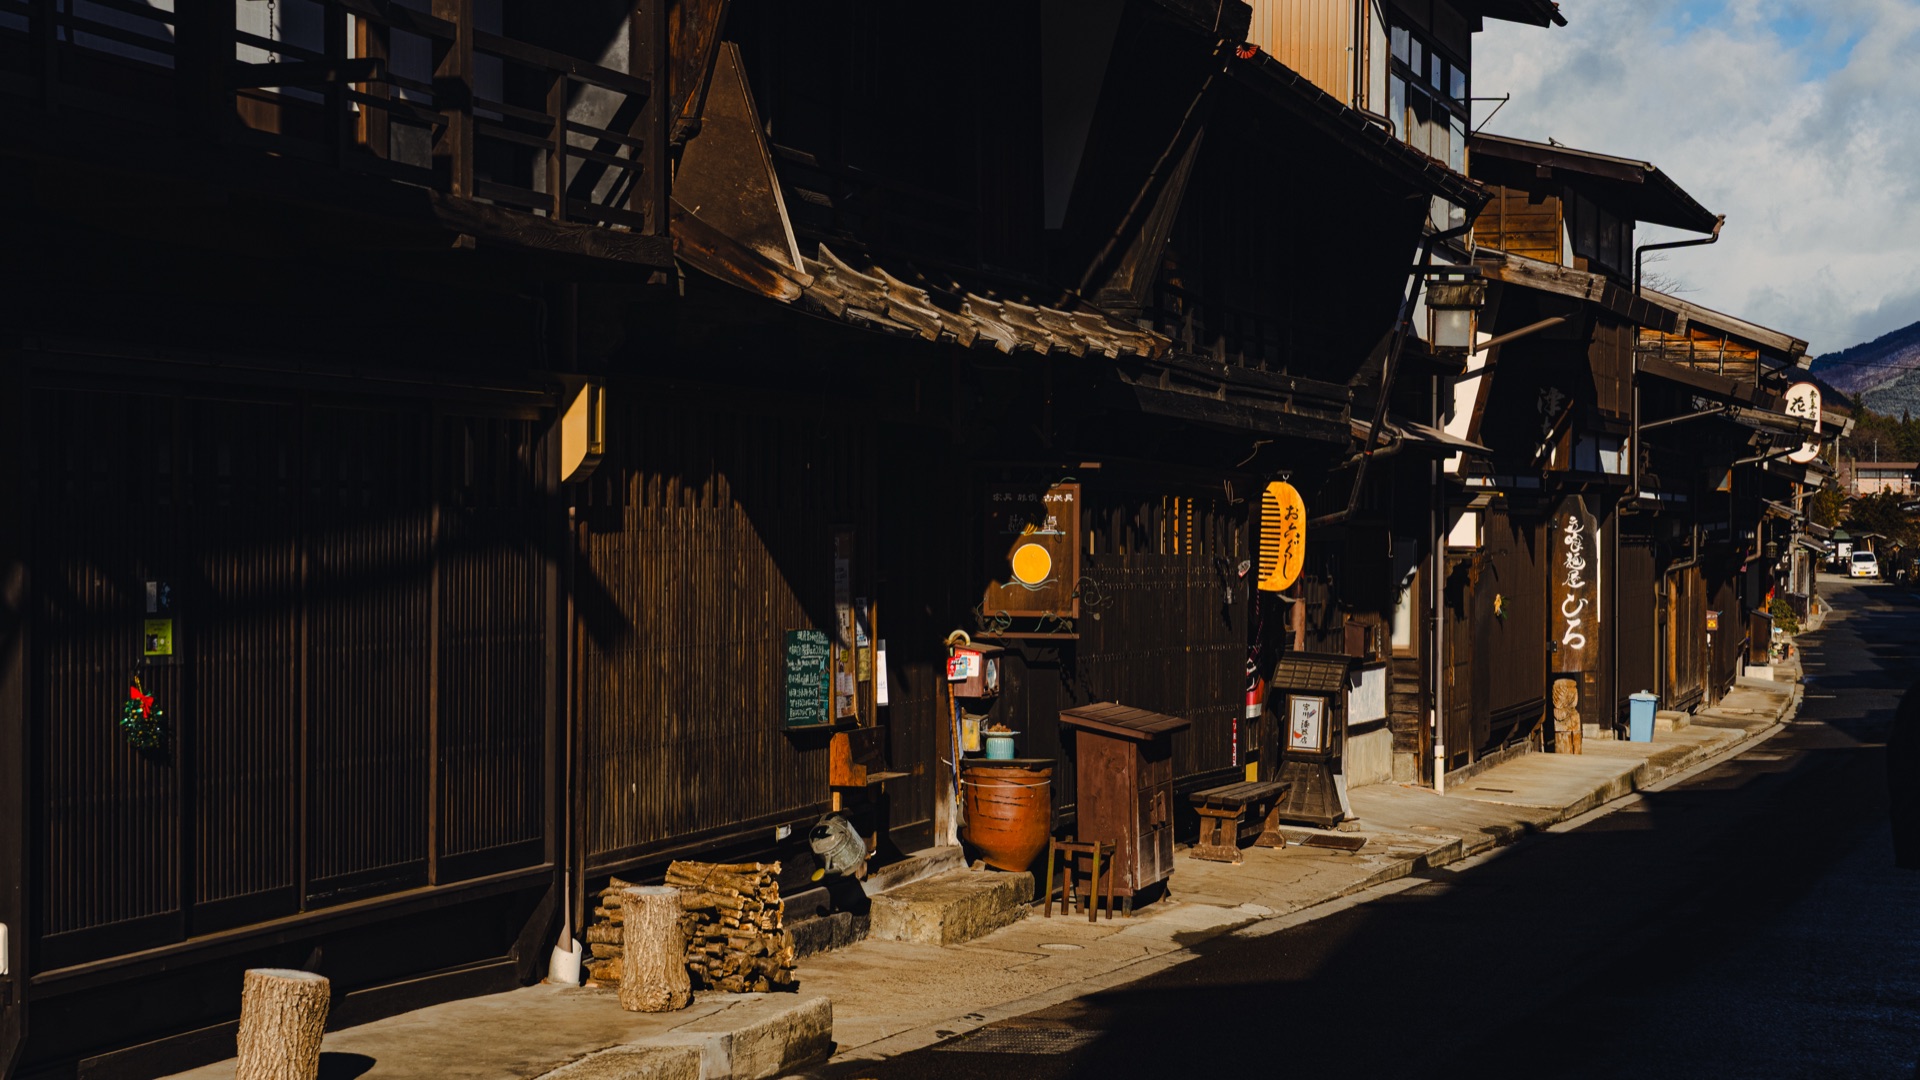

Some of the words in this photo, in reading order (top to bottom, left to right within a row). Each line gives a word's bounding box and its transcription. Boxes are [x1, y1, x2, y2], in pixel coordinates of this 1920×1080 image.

[992, 493, 1012, 502] 家具
[1043, 493, 1074, 503] 古民具
